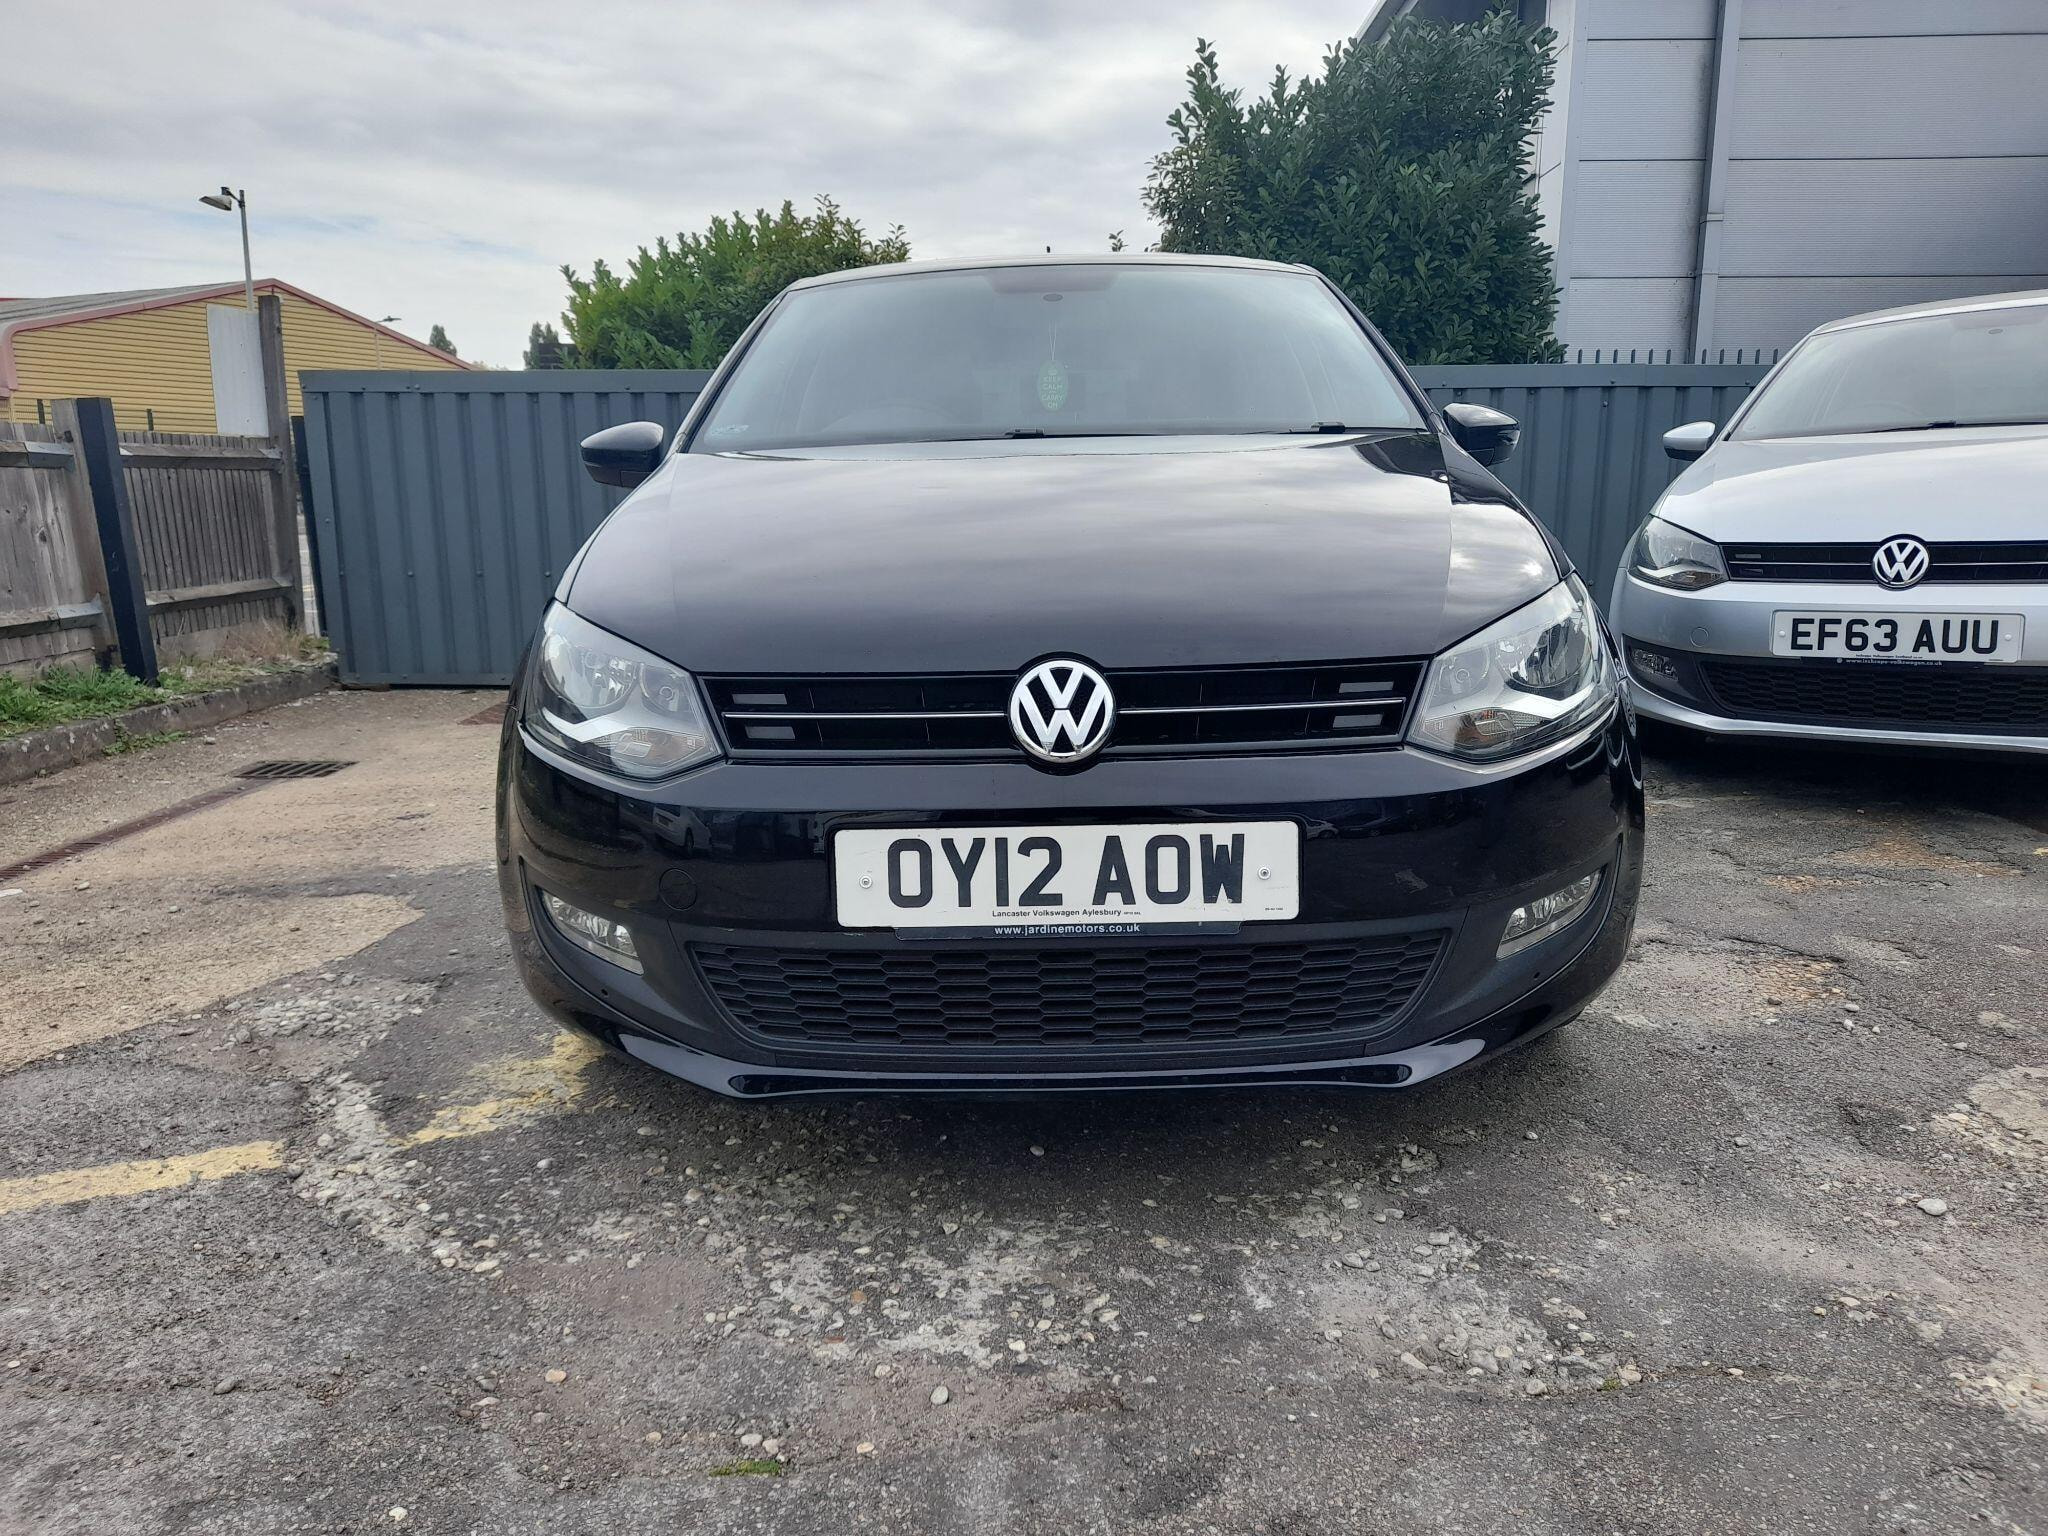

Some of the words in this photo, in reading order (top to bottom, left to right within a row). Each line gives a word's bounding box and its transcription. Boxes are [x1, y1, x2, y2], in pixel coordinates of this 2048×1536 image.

[1789, 617, 1899, 652] EF63
[1912, 619, 2000, 655] AUU
[887, 836, 1063, 908] OY12
[1092, 833, 1245, 906] AOW
[992, 909, 1031, 918] Lancaster
[1032, 908, 1080, 918] Volkswagen
[1082, 907, 1122, 917] Aylesbury
[994, 923, 1141, 937] www.jardinemotors.co.uk
